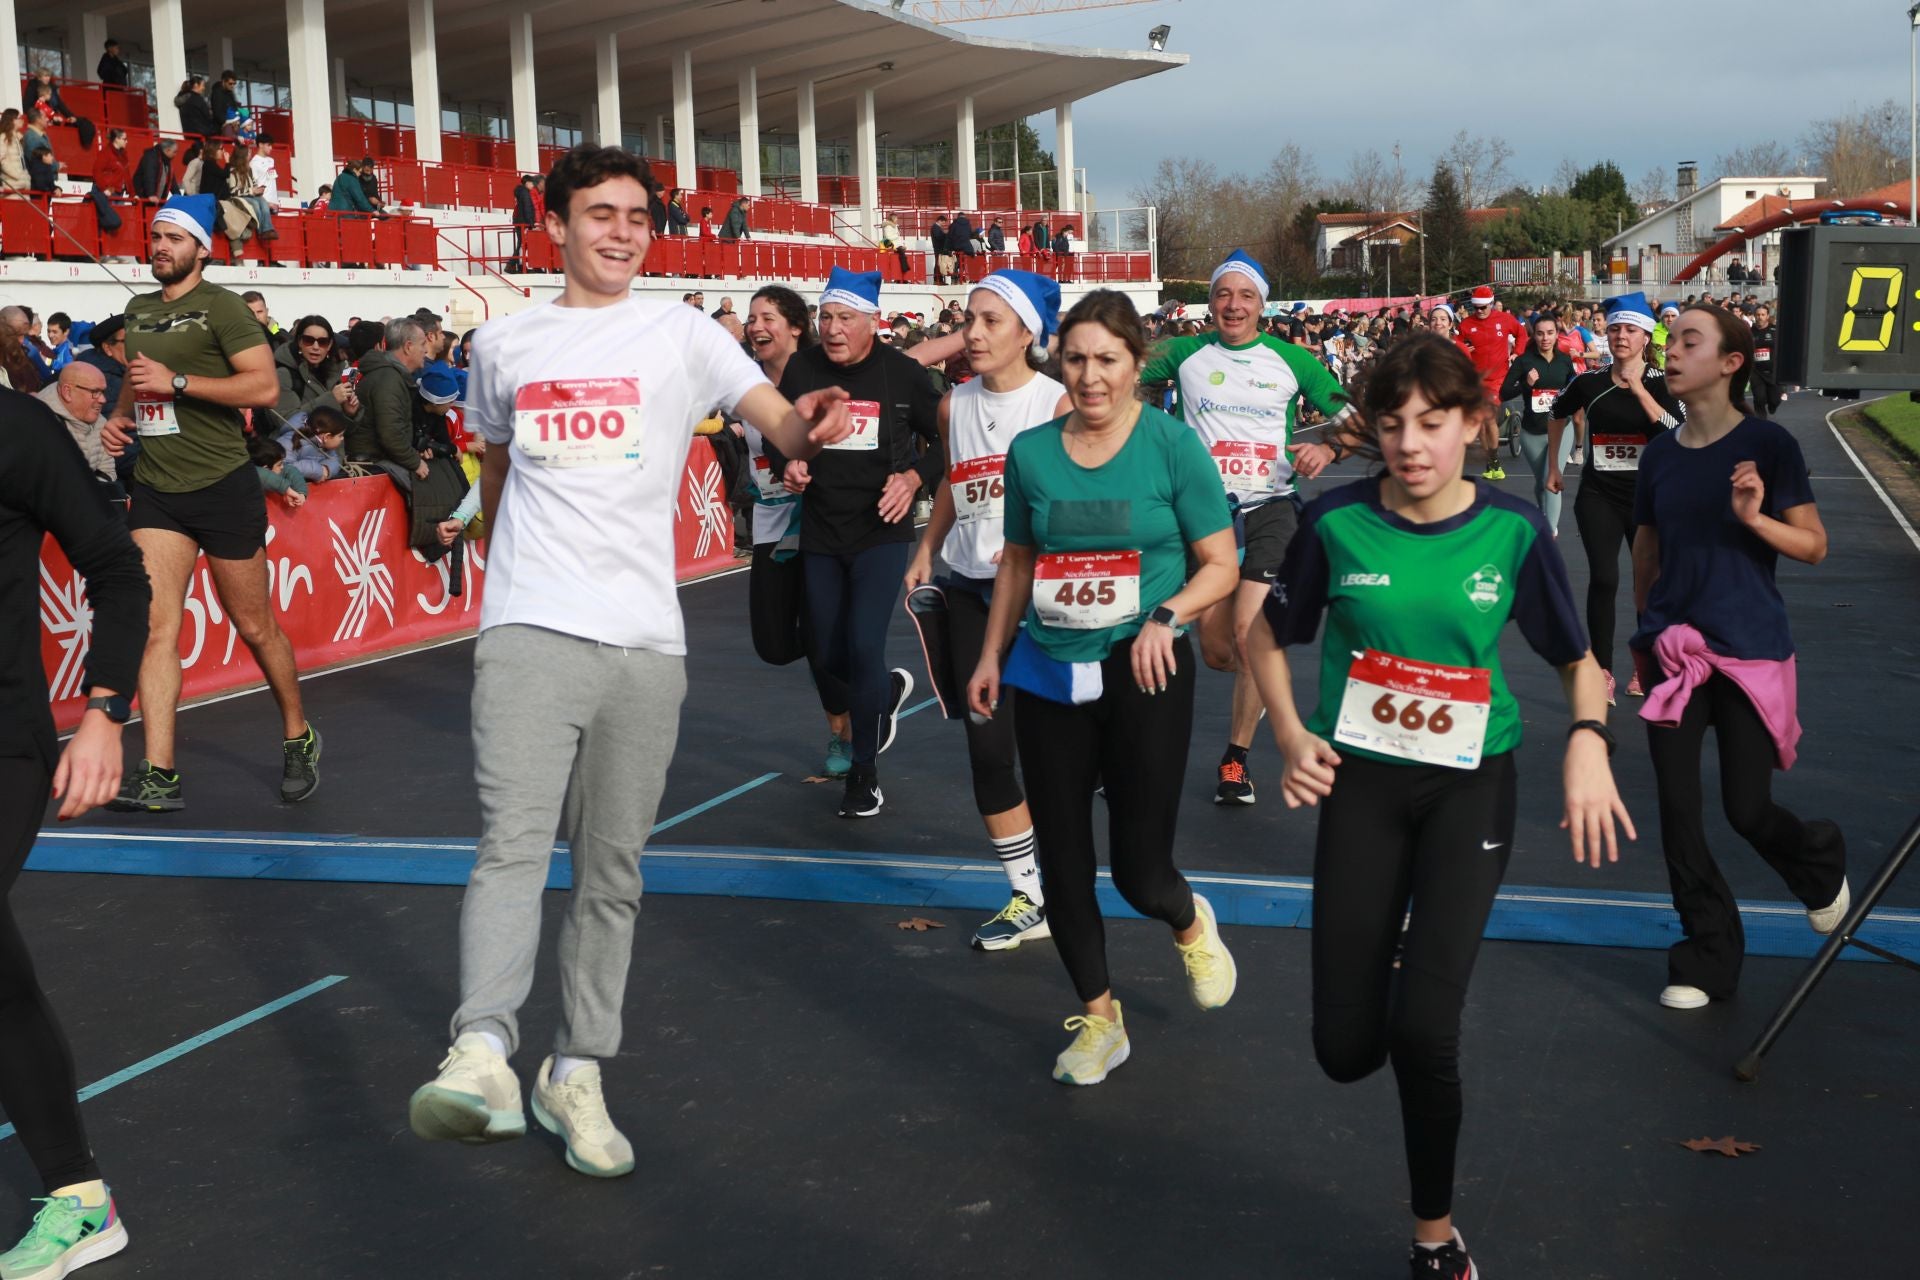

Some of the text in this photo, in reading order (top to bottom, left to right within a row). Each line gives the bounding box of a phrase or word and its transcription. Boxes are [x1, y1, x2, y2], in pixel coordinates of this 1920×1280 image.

[70, 266, 80, 276] 19
[132, 268, 141, 277] 21
[249, 270, 258, 279] 25
[534, 410, 625, 442] 1100
[1605, 446, 1638, 459] 552
[1219, 458, 1270, 477] 1036
[966, 478, 1004, 504] 576
[1340, 573, 1391, 587] LEGEA
[1054, 580, 1116, 607] 465
[1372, 693, 1453, 735] 666
